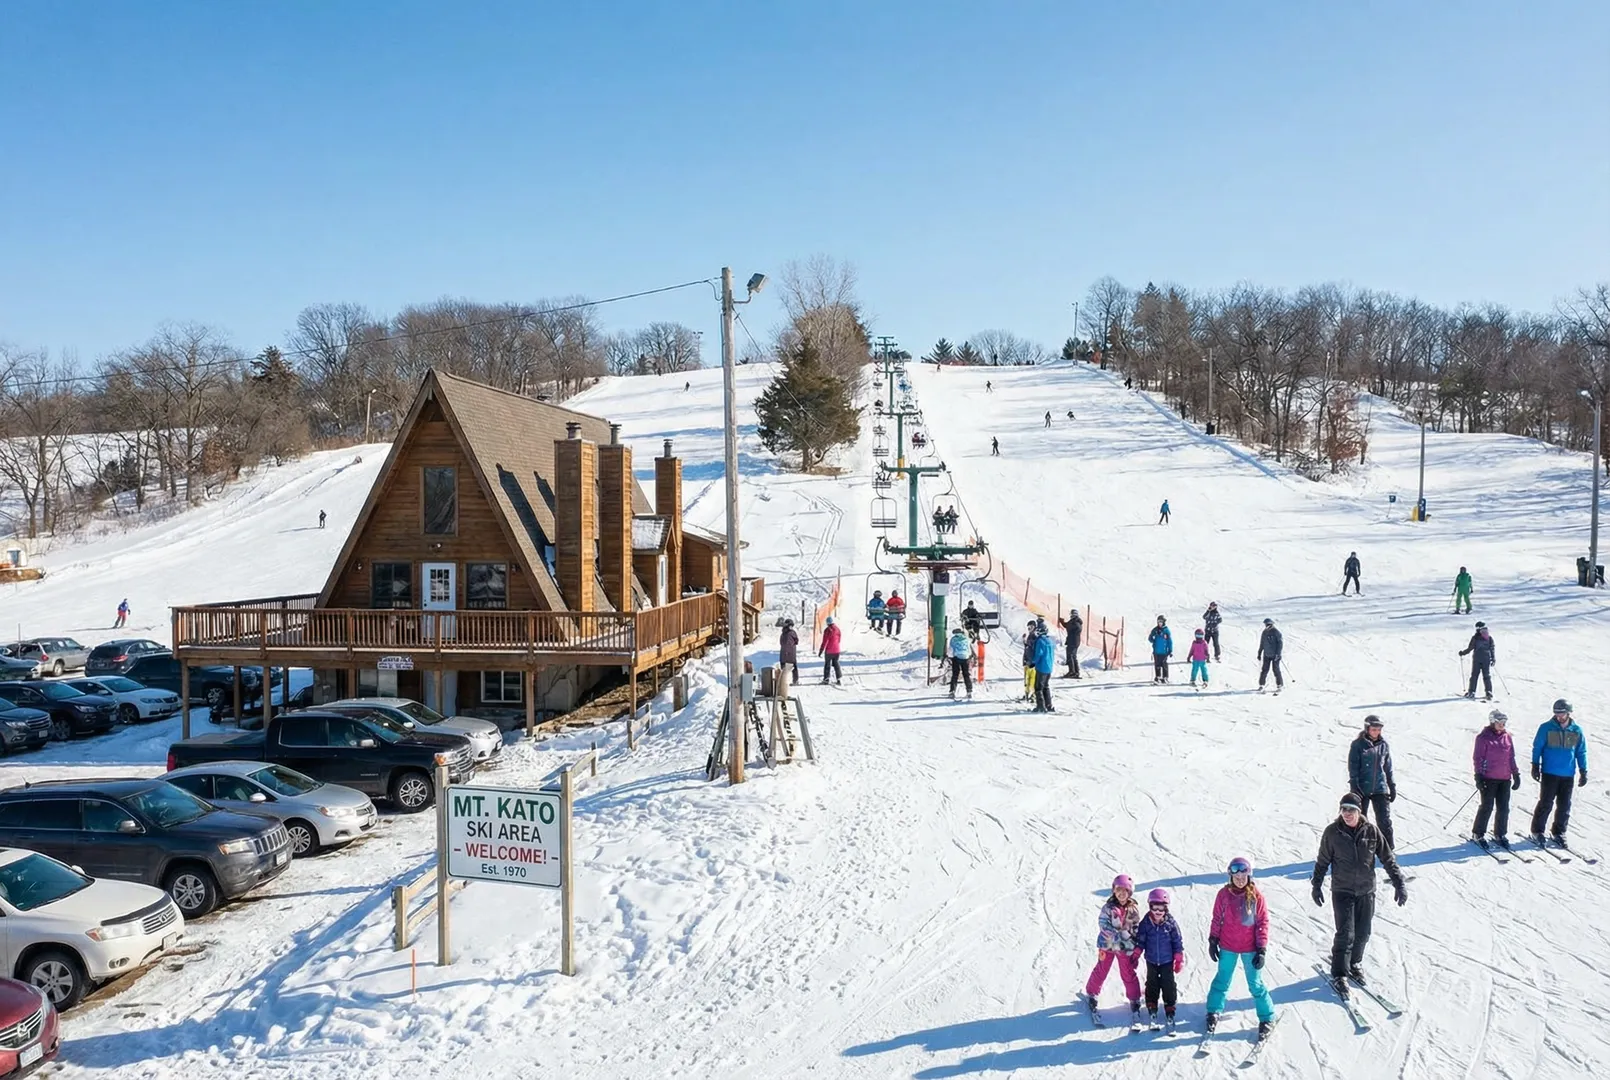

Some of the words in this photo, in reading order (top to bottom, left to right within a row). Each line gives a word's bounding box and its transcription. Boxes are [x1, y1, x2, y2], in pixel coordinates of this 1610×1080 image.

[454, 796, 489, 817] MT.
[497, 797, 554, 824] KATO
[467, 821, 492, 838] SKI
[498, 823, 542, 843] AREA
[465, 843, 547, 864] WELCOME!
[482, 863, 499, 875] Est.
[503, 866, 526, 878] 1970
